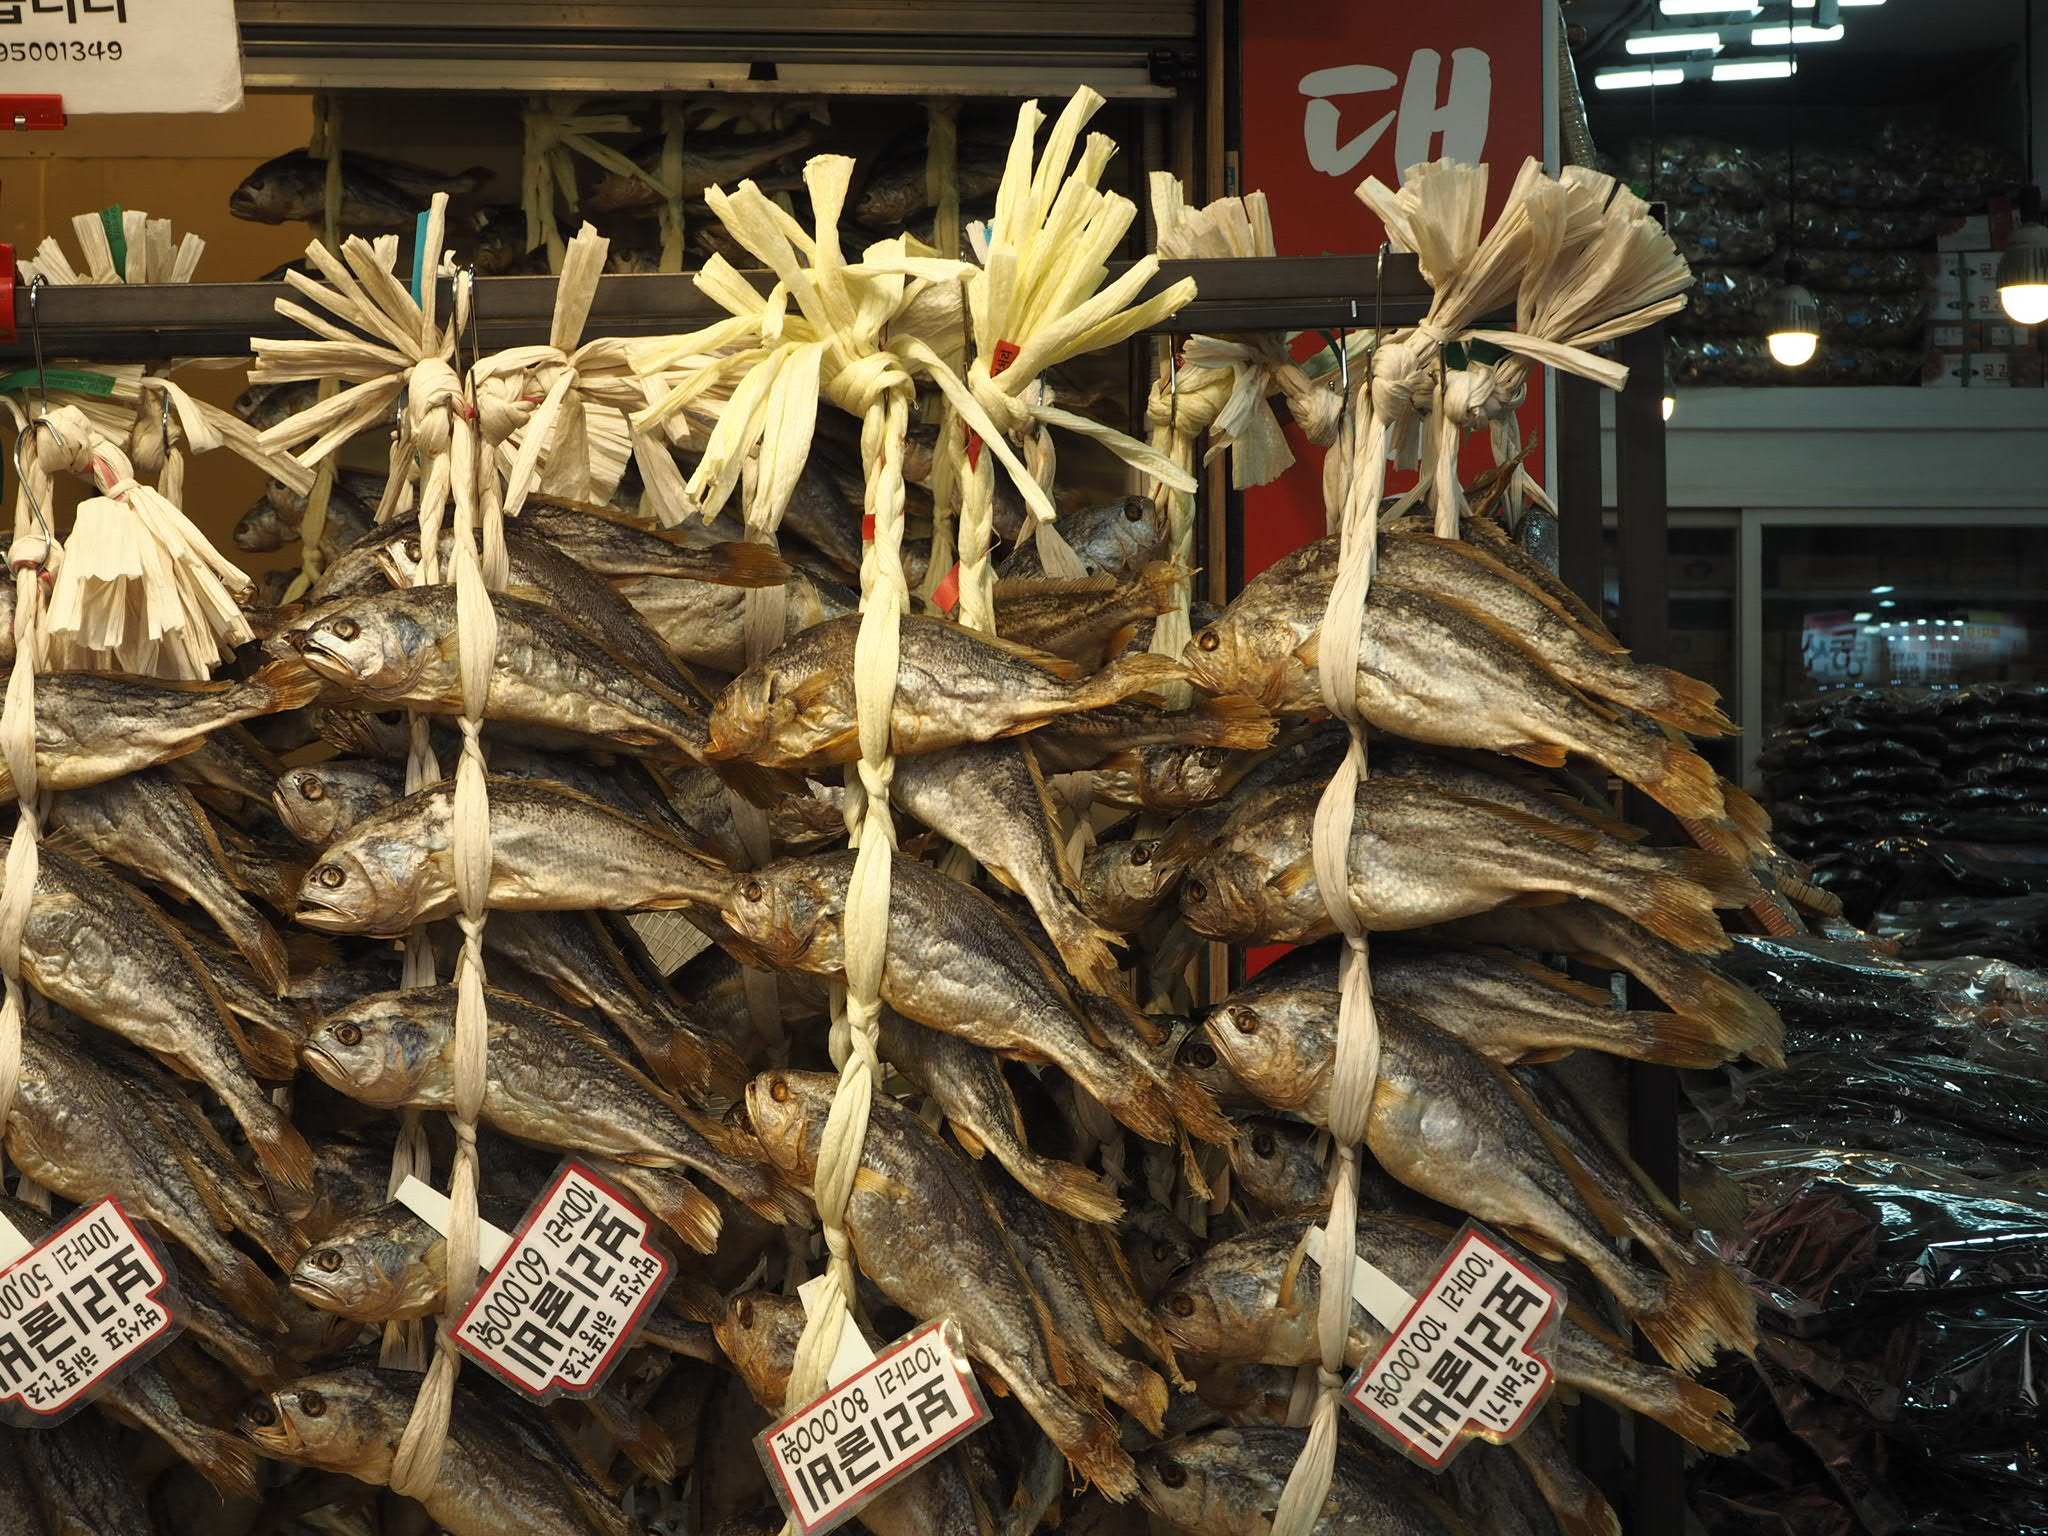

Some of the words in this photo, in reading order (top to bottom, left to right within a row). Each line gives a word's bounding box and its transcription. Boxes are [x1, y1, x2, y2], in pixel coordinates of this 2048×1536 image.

[1299, 47, 1491, 186] 대
[53, 1217, 118, 1275] 10마리
[543, 1181, 597, 1248] 10마리
[467, 1248, 549, 1349] 60,000원
[502, 1205, 640, 1378] 보리굴비
[610, 1256, 658, 1307] 법성포
[1438, 1252, 1493, 1312] 10마리
[102, 1304, 161, 1350] 법성포
[559, 1311, 616, 1379] 해풍건조
[1400, 1271, 1543, 1447] 보리굴비
[25, 1346, 98, 1404] 해풍건조
[875, 1345, 940, 1399] 10마리
[1365, 1316, 1447, 1408] 100,000원
[1479, 1356, 1540, 1426] 알배기
[777, 1388, 868, 1464] 80,000원
[795, 1375, 957, 1512] 보리굴비
